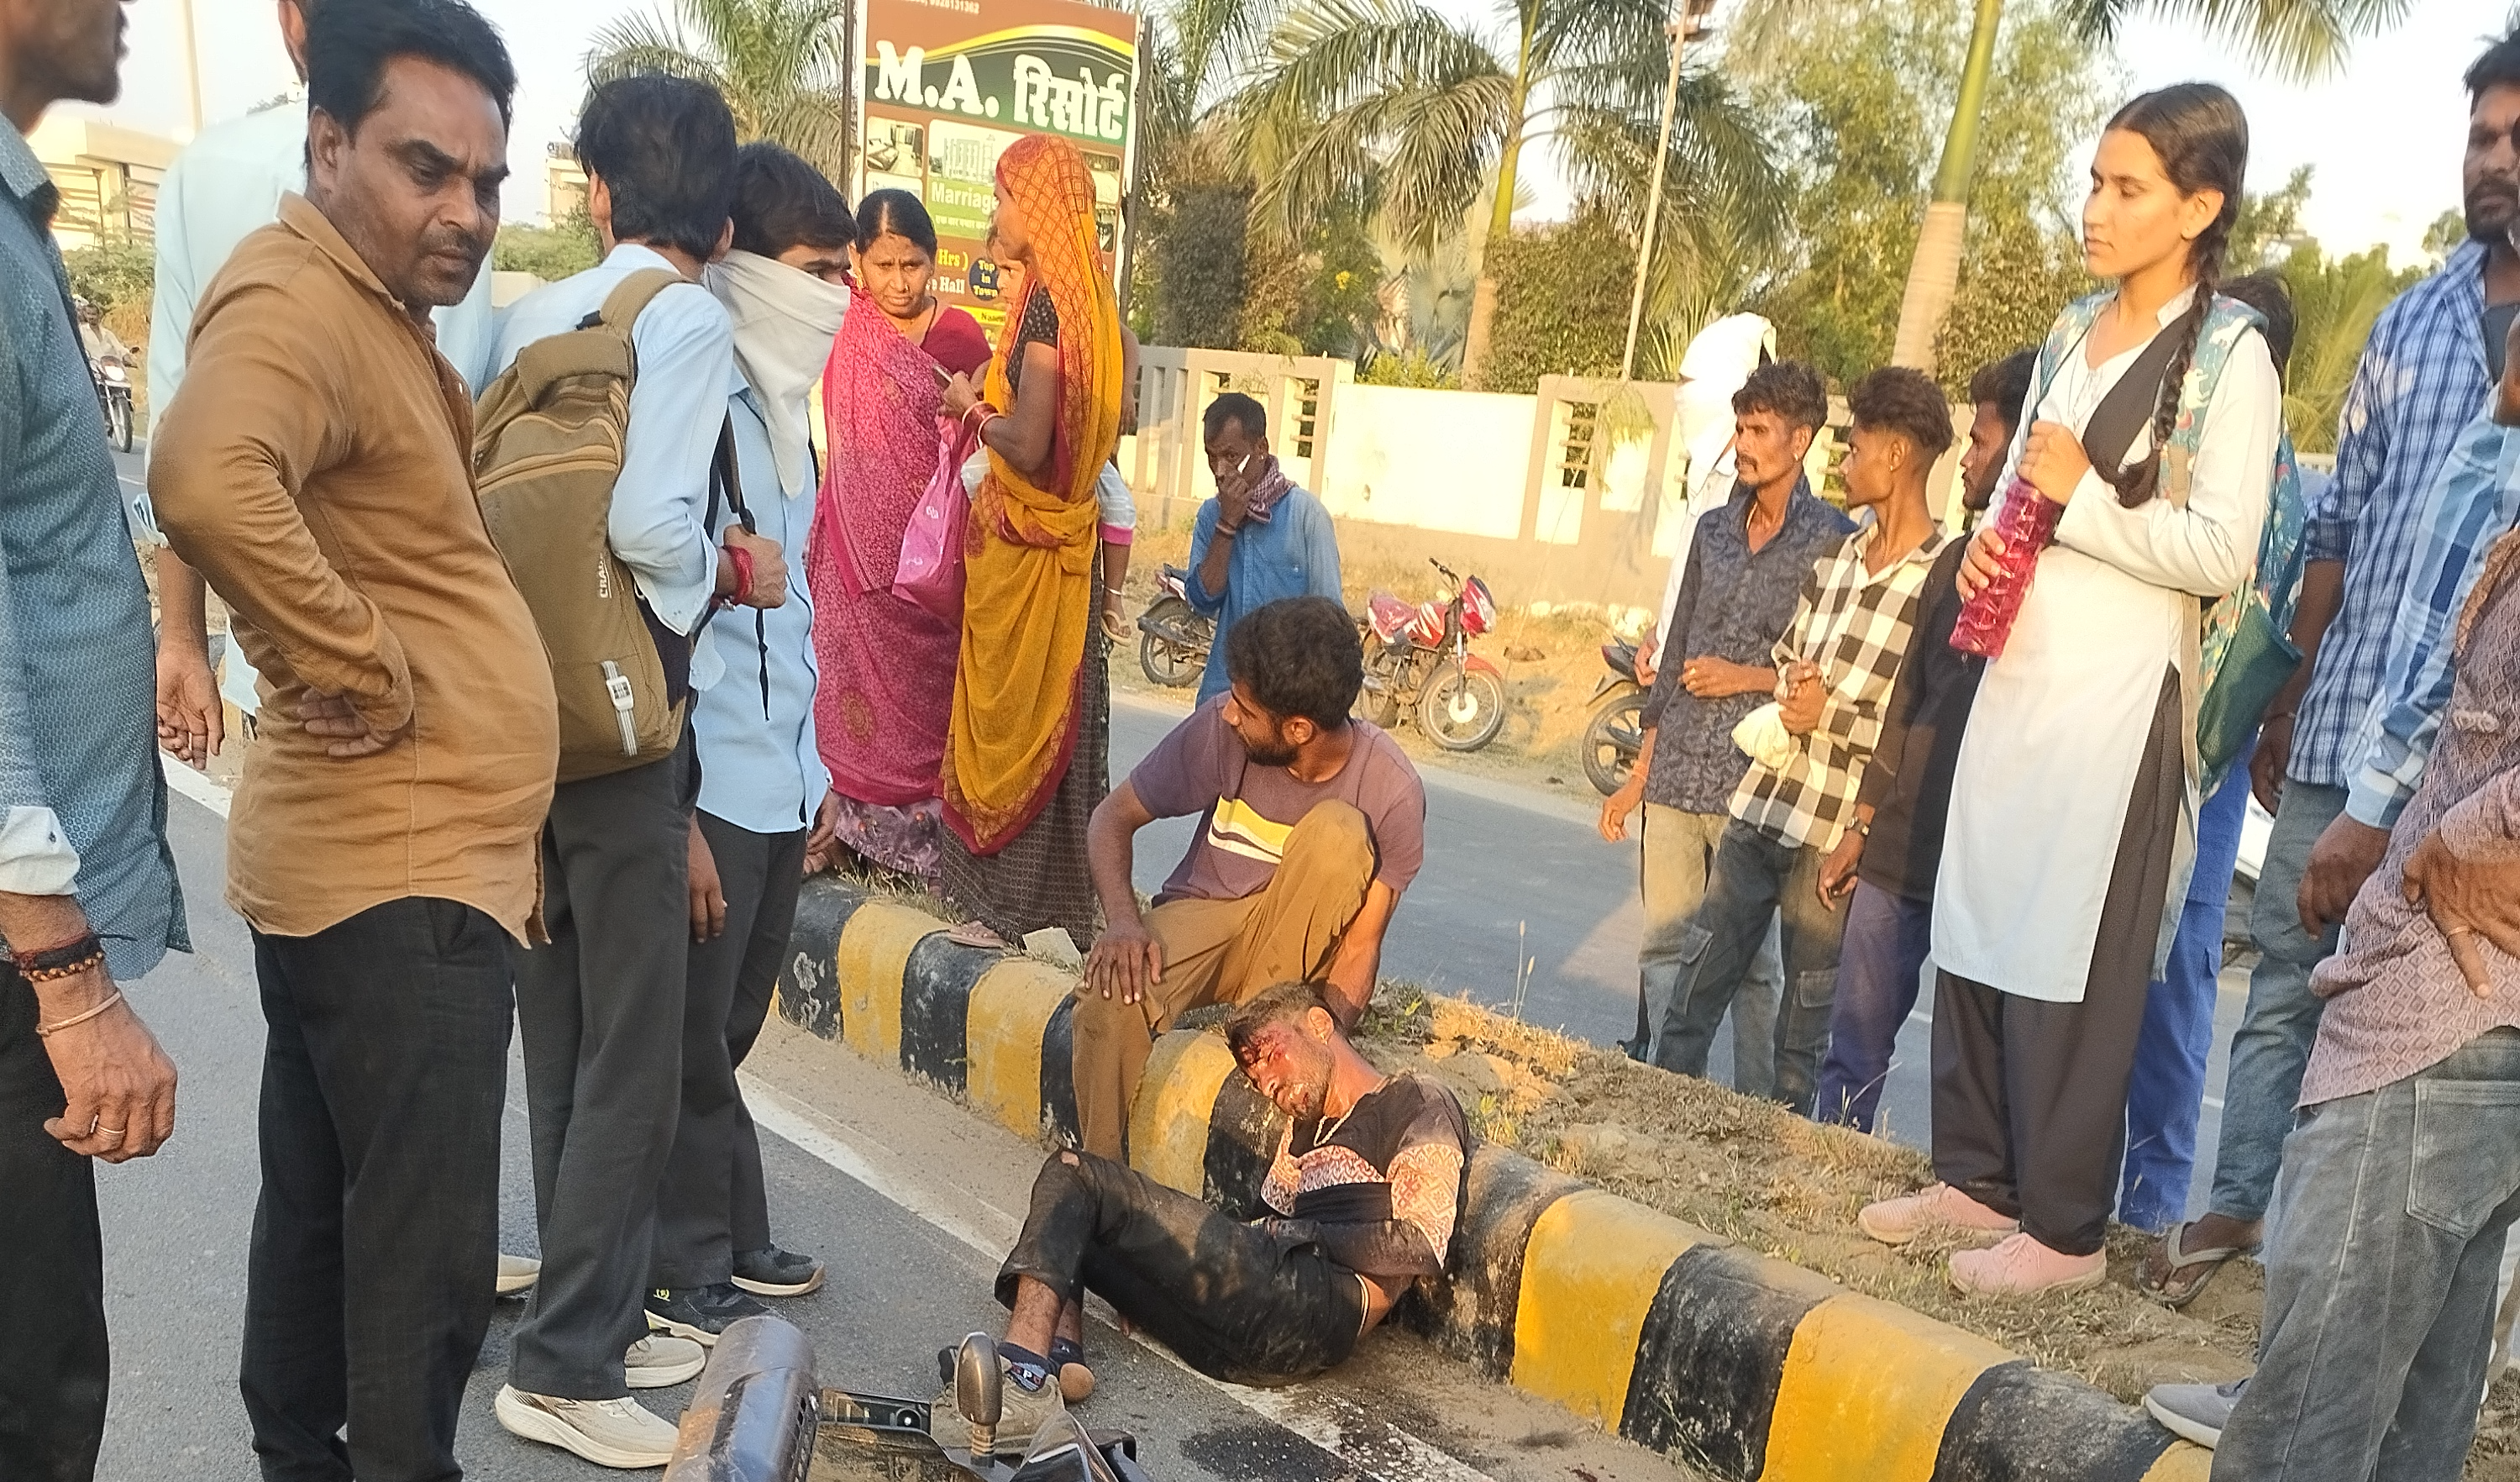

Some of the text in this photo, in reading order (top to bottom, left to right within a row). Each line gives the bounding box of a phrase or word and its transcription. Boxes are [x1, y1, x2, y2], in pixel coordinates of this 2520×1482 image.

[874, 40, 1126, 140] M.A. रिसोर्ट
[931, 181, 1000, 215] Marriage
[937, 249, 960, 266] Hrs
[979, 260, 995, 273] Top
[939, 276, 965, 294] Hall
[974, 285, 998, 297] Town
